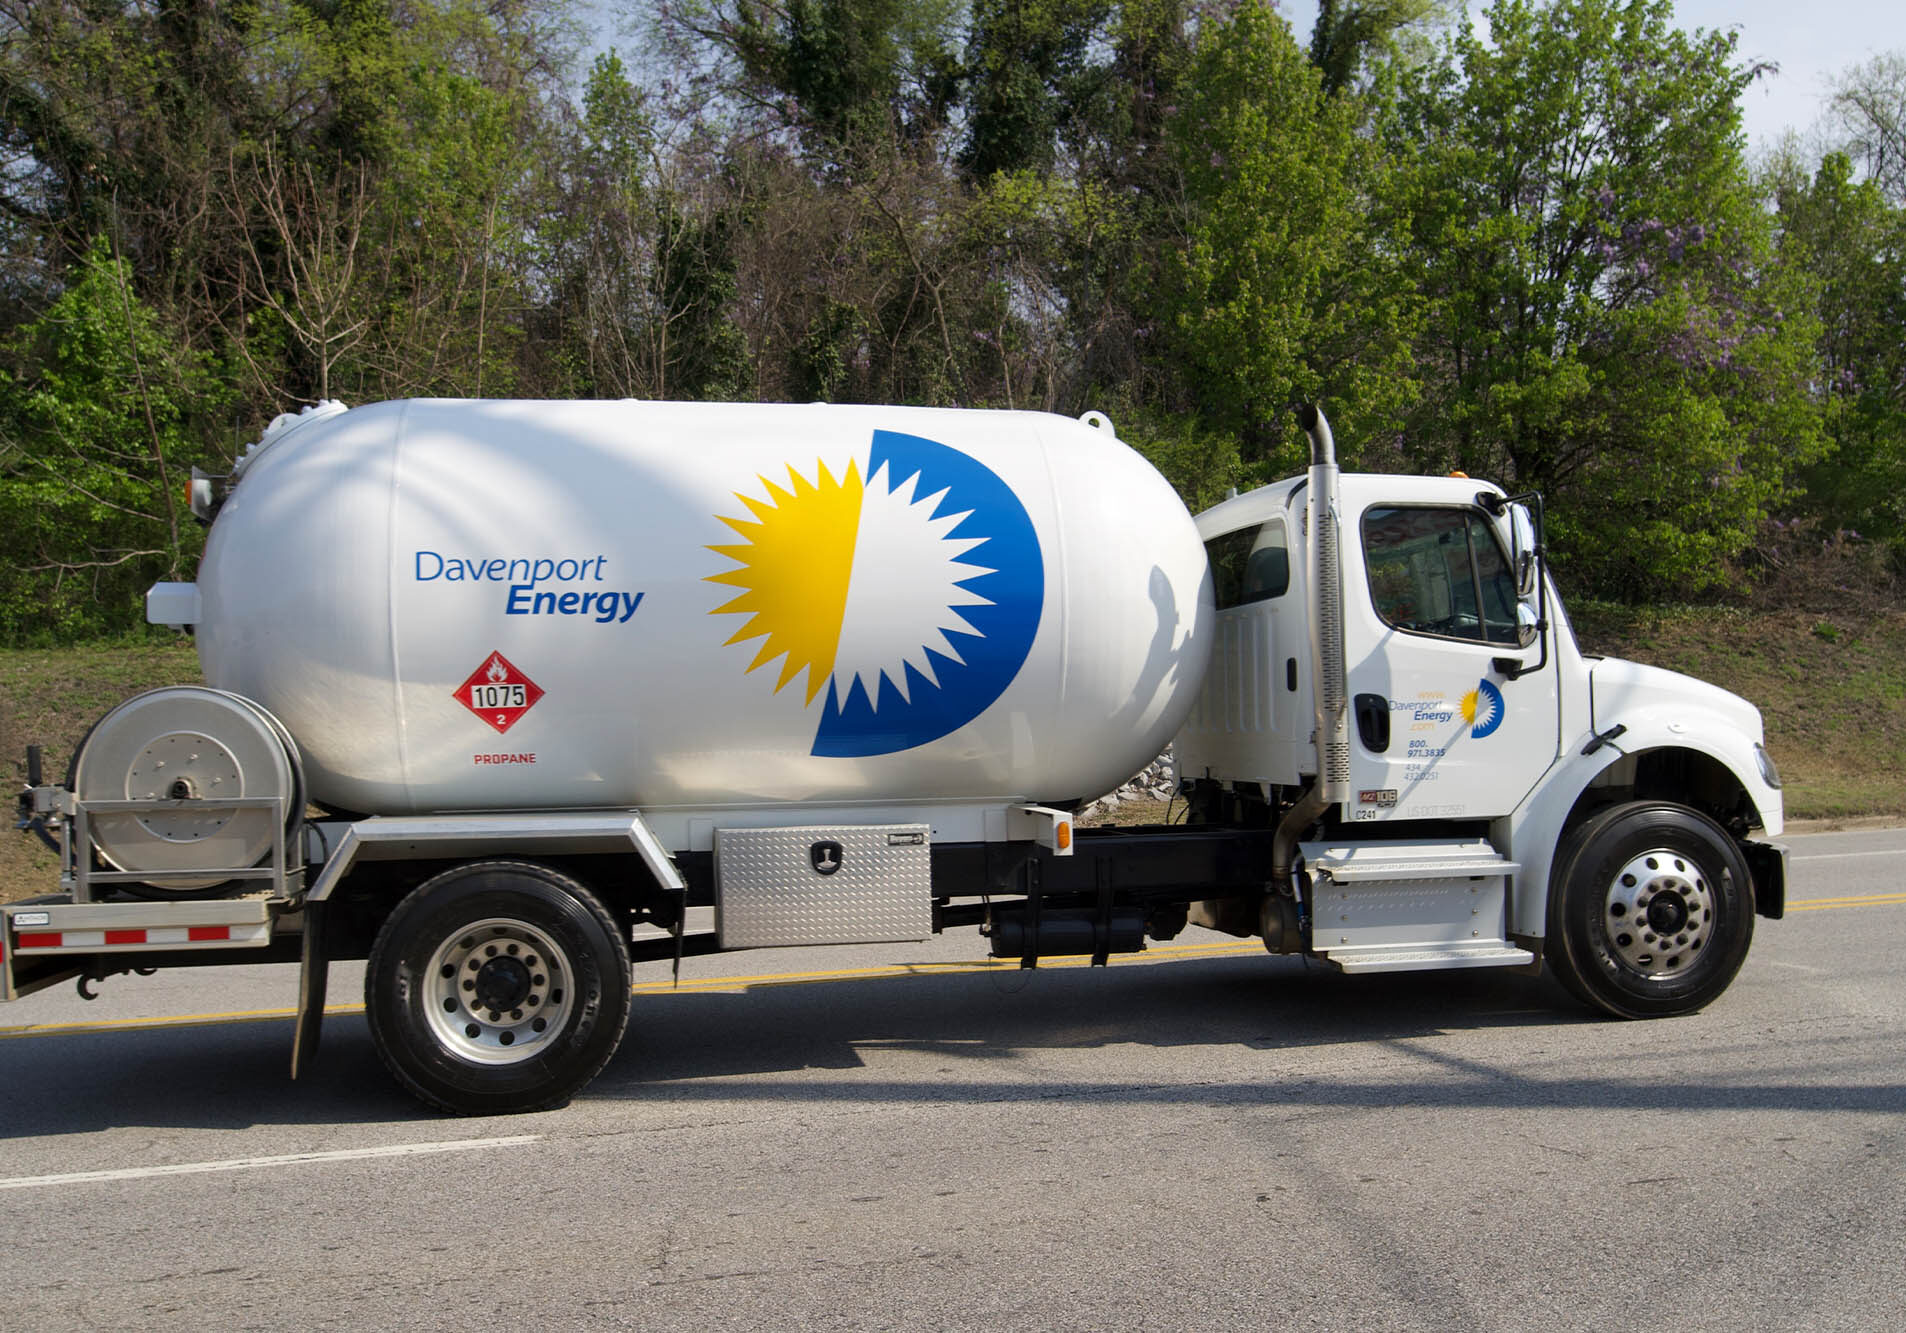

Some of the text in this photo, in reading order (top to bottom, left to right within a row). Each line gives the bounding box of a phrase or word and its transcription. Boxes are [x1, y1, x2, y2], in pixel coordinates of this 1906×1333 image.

[415, 551, 608, 585] Davenport
[505, 584, 645, 624] Energy
[474, 685, 525, 708] 1075
[1389, 700, 1443, 712] Davenport
[496, 714, 507, 725] 2
[1414, 710, 1454, 722] Energy
[473, 752, 537, 765] PROPANE
[1407, 749, 1446, 758] 971.3835
[1355, 809, 1376, 820] C241
